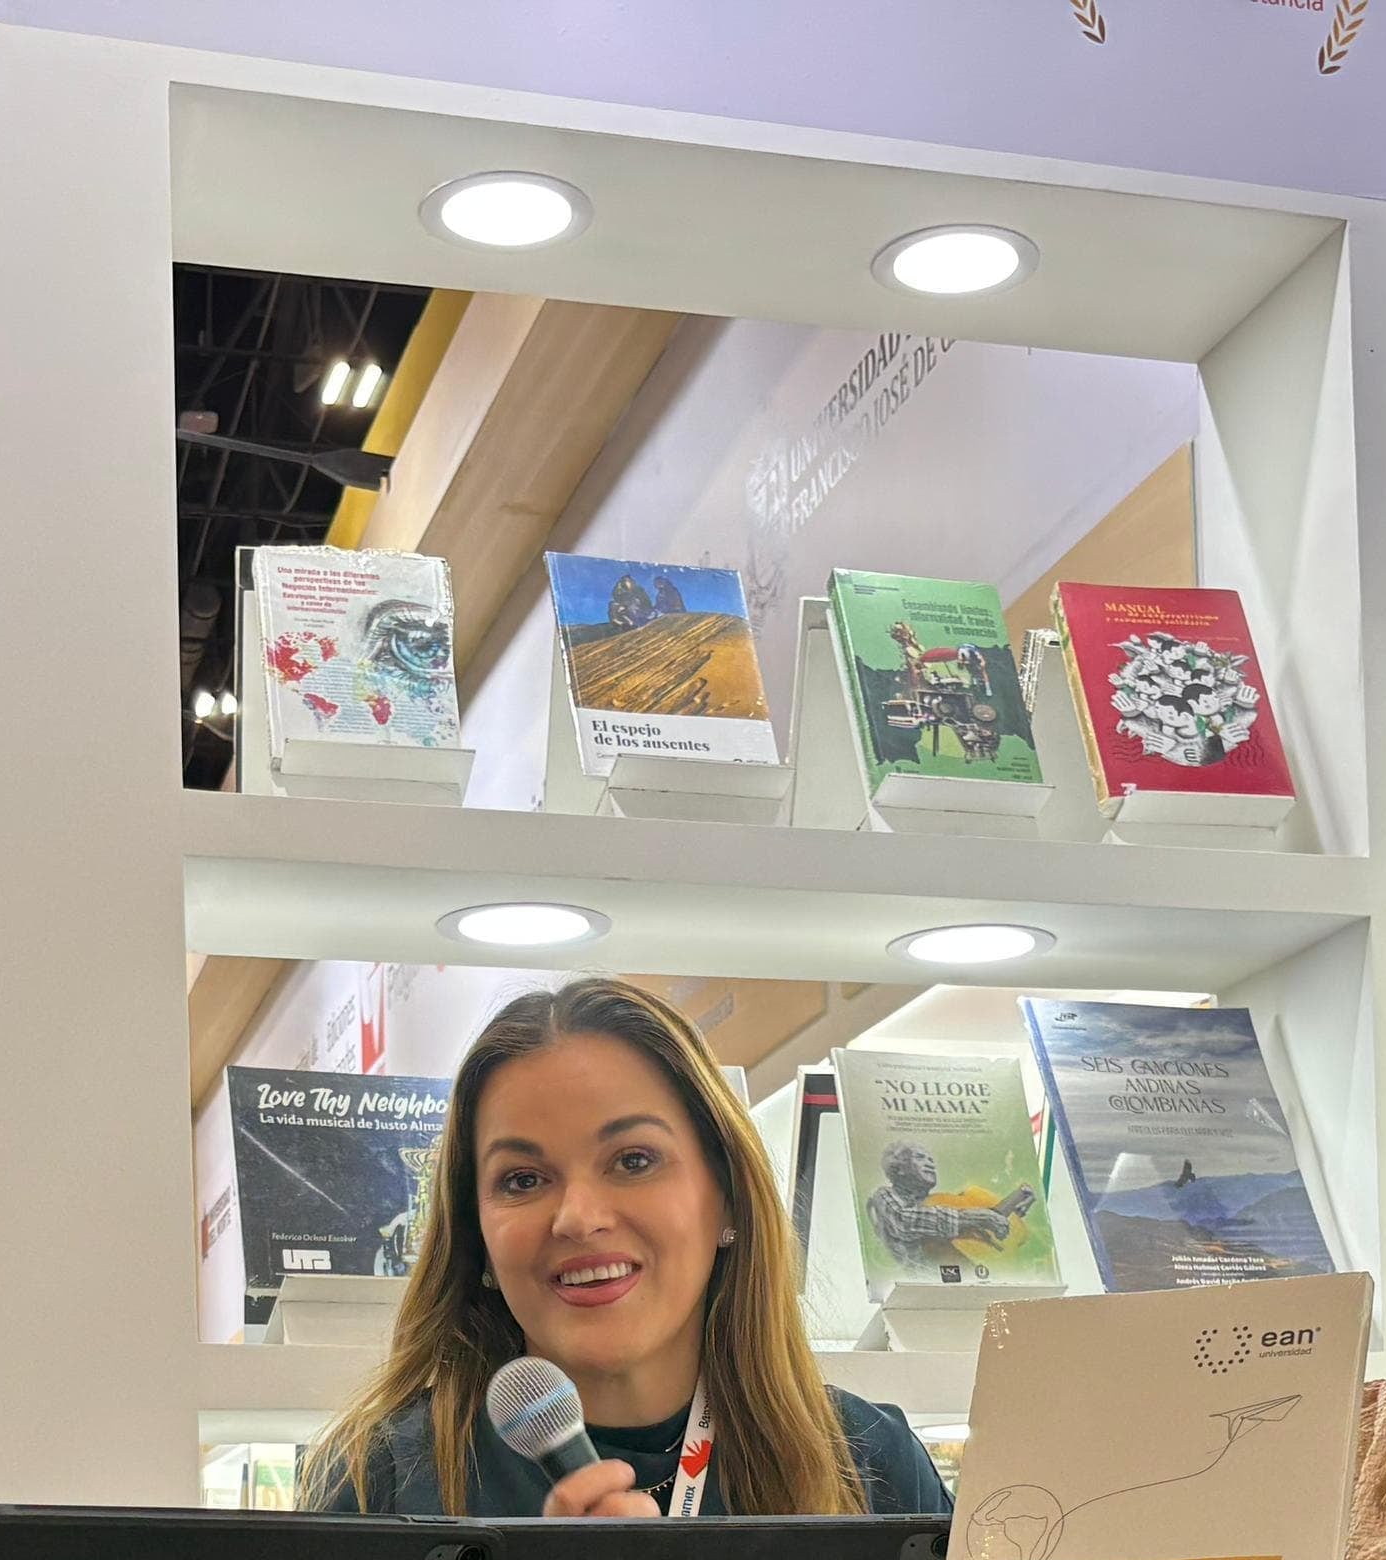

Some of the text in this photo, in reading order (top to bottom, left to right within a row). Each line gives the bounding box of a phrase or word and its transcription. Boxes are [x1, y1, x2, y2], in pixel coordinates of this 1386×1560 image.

[874, 352, 910, 439] JOSÉ
[913, 336, 938, 388] DE
[592, 720, 661, 736] El espejo
[594, 734, 710, 751] de los ausentes
[1081, 1056, 1229, 1078] SEIS CANCIONES
[919, 1082, 990, 1096] LLORE
[1126, 1078, 1201, 1095] ANDINAS
[257, 1083, 306, 1109] Love
[310, 1087, 351, 1117] Thy
[881, 1097, 906, 1111] MI
[1109, 1095, 1226, 1114] COLOMBIANAS
[260, 1112, 274, 1124] La
[277, 1115, 304, 1125] vida
[306, 1117, 355, 1129] musical
[357, 1118, 372, 1129] de
[375, 1119, 407, 1131] Justo
[272, 1232, 302, 1242] Federico
[1261, 1329, 1313, 1347] ean
[1259, 1348, 1312, 1358] universidad
